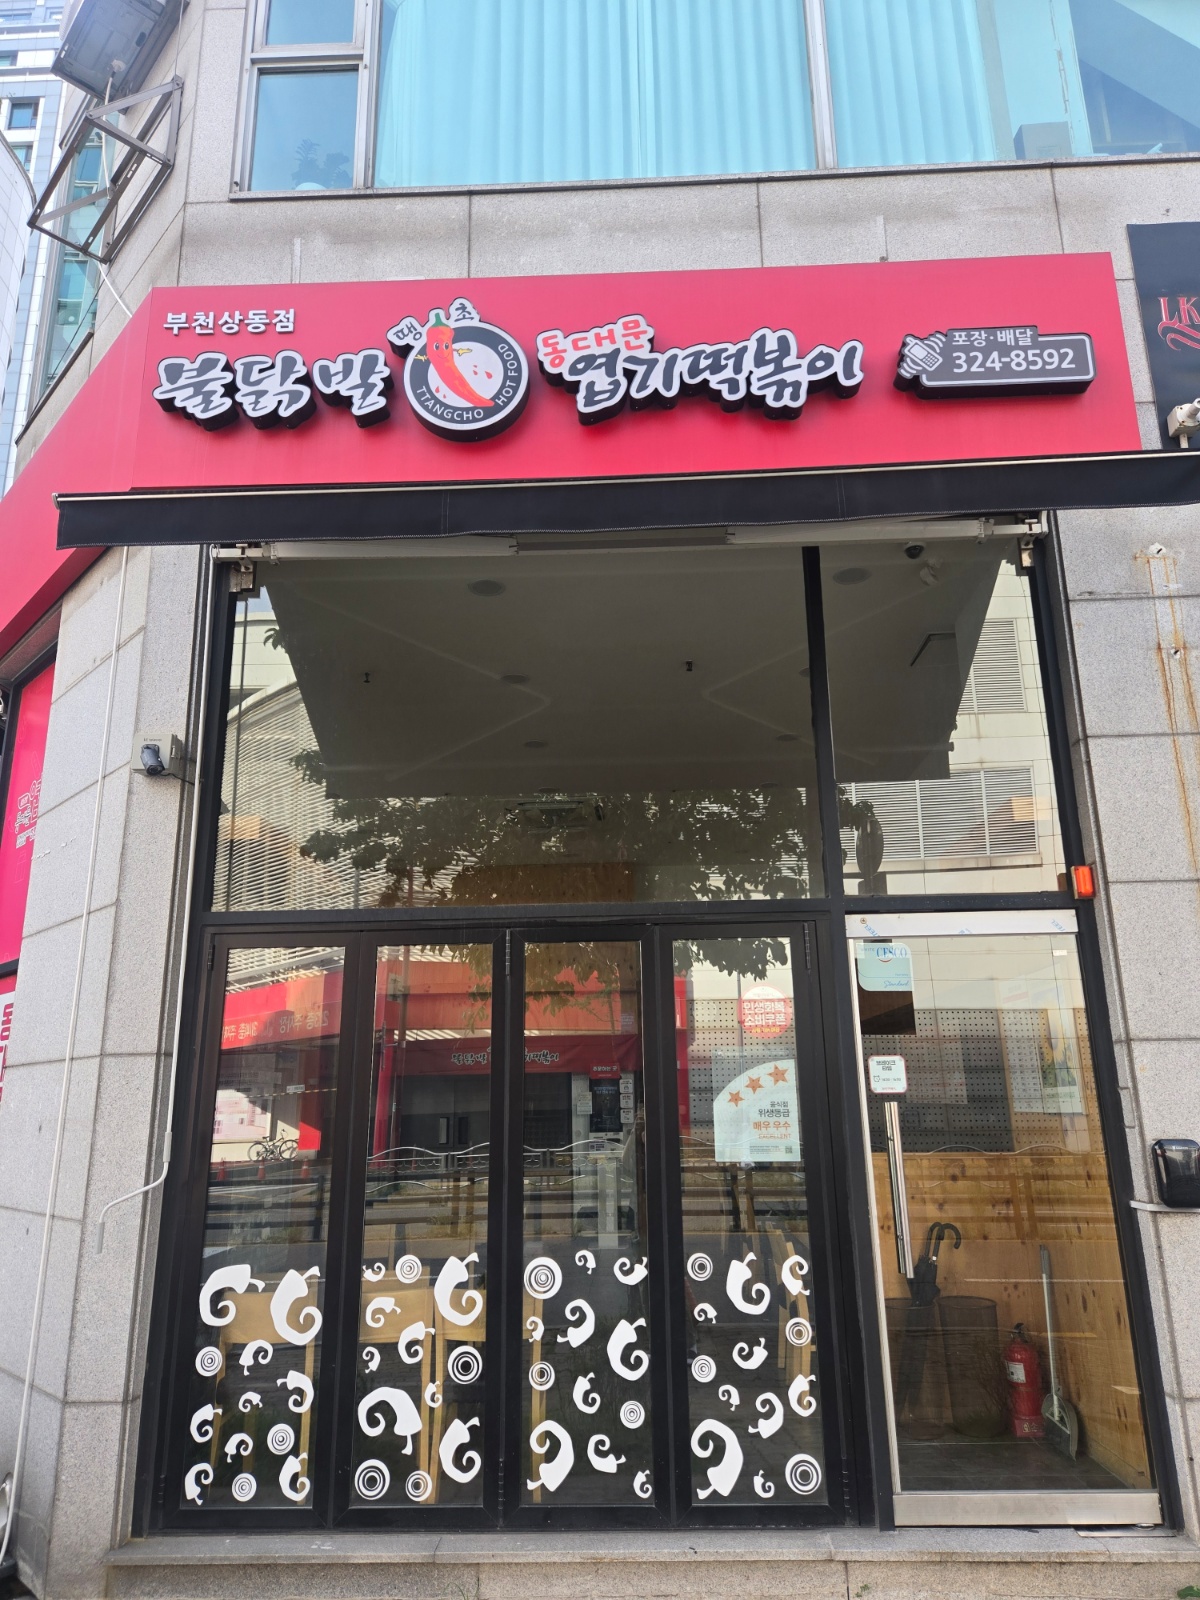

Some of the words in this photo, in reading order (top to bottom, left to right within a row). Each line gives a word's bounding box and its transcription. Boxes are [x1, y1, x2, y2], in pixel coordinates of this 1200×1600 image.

[163, 309, 295, 335] 부천상동점
[542, 319, 647, 368] 동대문
[498, 344, 519, 376] FOOD
[568, 334, 858, 408] 엽기떡볶이
[952, 348, 1076, 373] 324-8592
[157, 354, 384, 414] 불닭발
[495, 380, 517, 406] HOT
[417, 386, 484, 420] TTANGCHO
[876, 947, 907, 958] CESCO
[744, 1013, 786, 1026] 소비쿠폰
[753, 1121, 771, 1131] 매우
[773, 1121, 791, 1131] 우수
[758, 1108, 790, 1118] 위생등급
